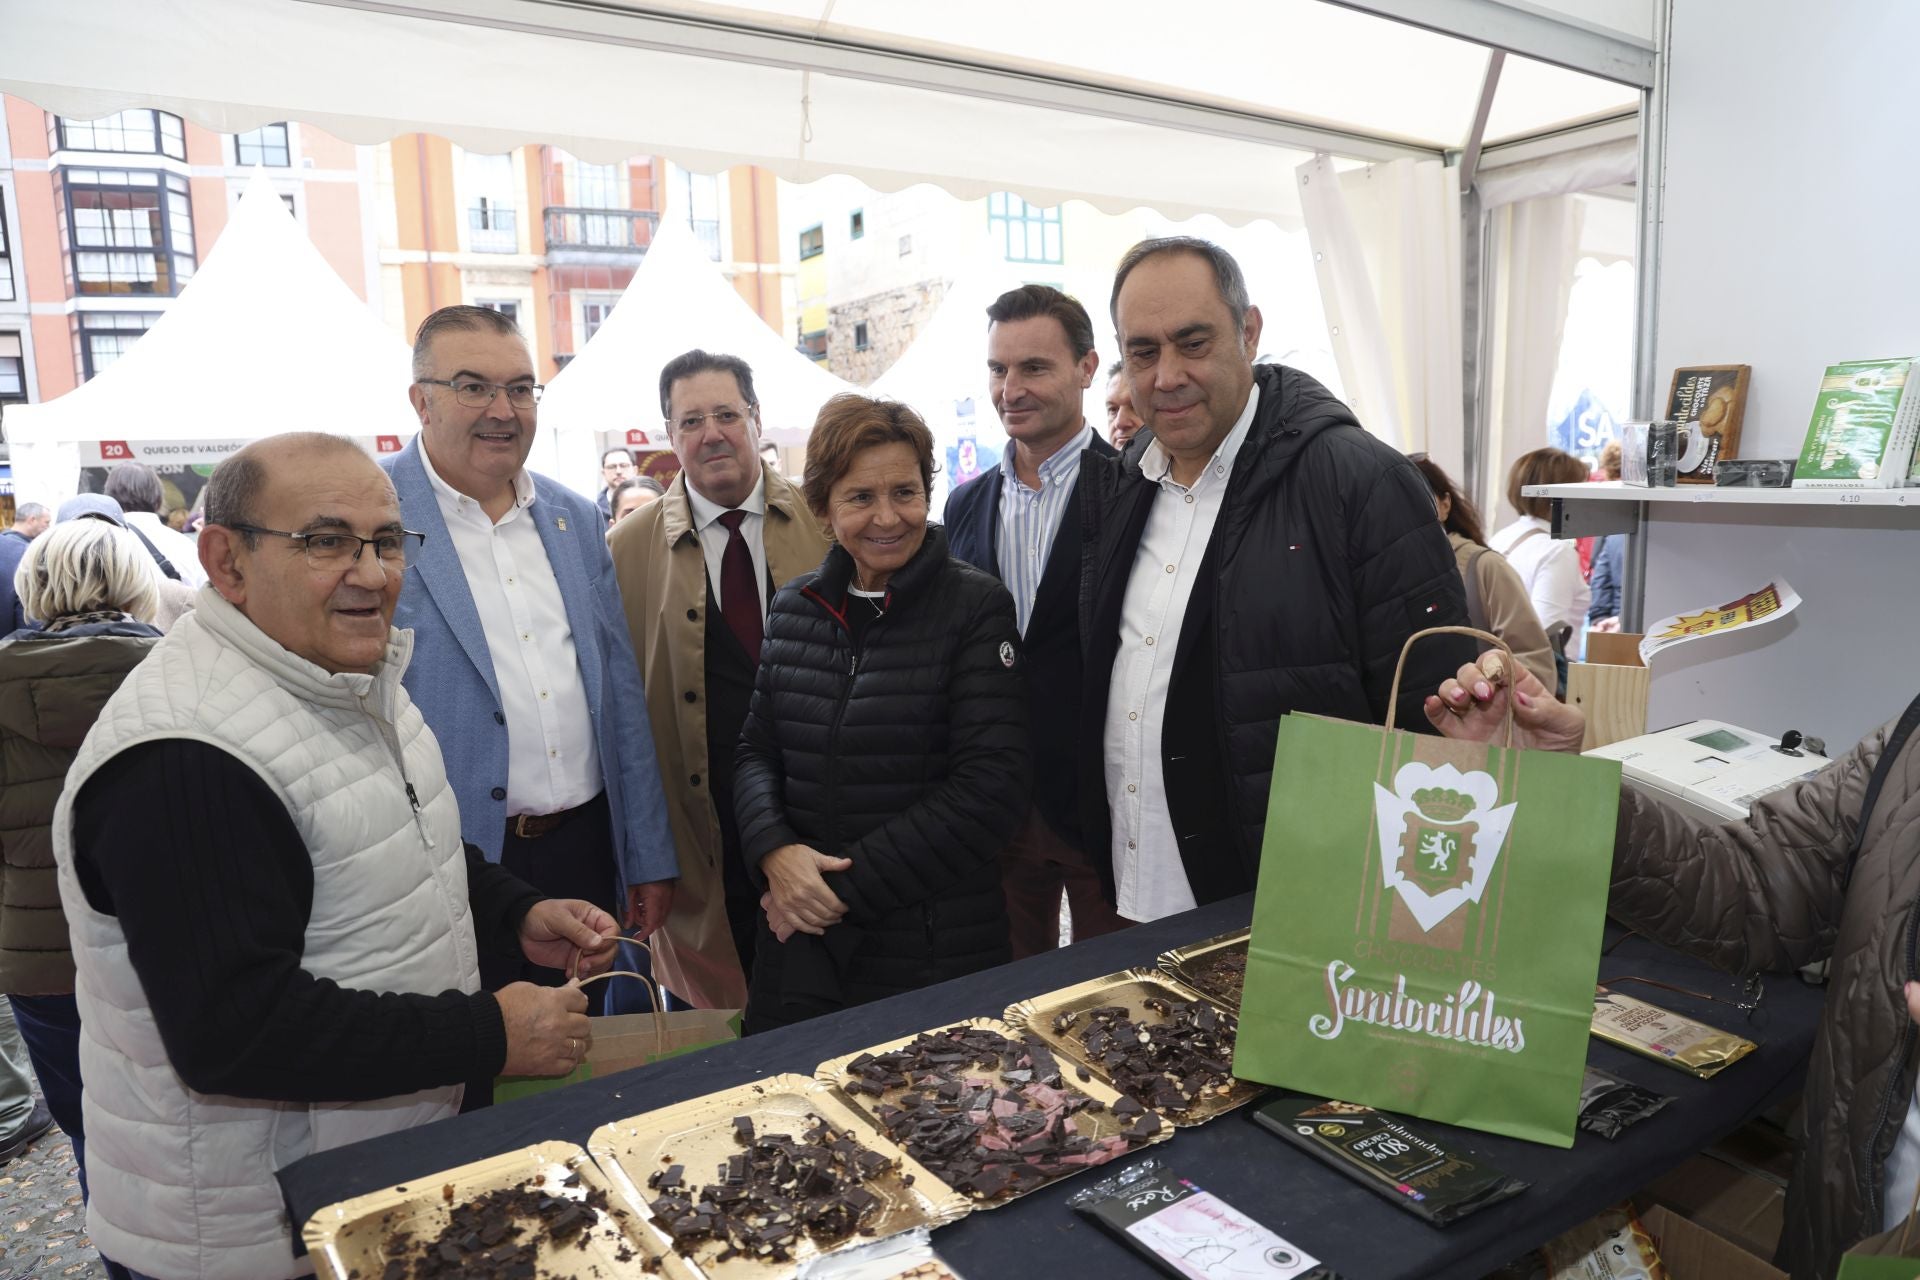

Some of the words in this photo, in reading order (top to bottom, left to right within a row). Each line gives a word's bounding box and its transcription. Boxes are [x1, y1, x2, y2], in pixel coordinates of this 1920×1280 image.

[1690, 376, 1706, 417] CHOCOLATE
[1701, 376, 1713, 397] TAZA
[105, 444, 123, 456] 20
[143, 446, 178, 455] QUESO
[180, 445, 195, 454] DE
[198, 441, 243, 453] VALDEÓ
[1839, 494, 1861, 503] 4.10
[1354, 939, 1498, 982] CHOCOLATES
[1352, 1132, 1391, 1151] cacao
[1362, 1138, 1410, 1161] 80%
[1387, 1122, 1445, 1157] almendra
